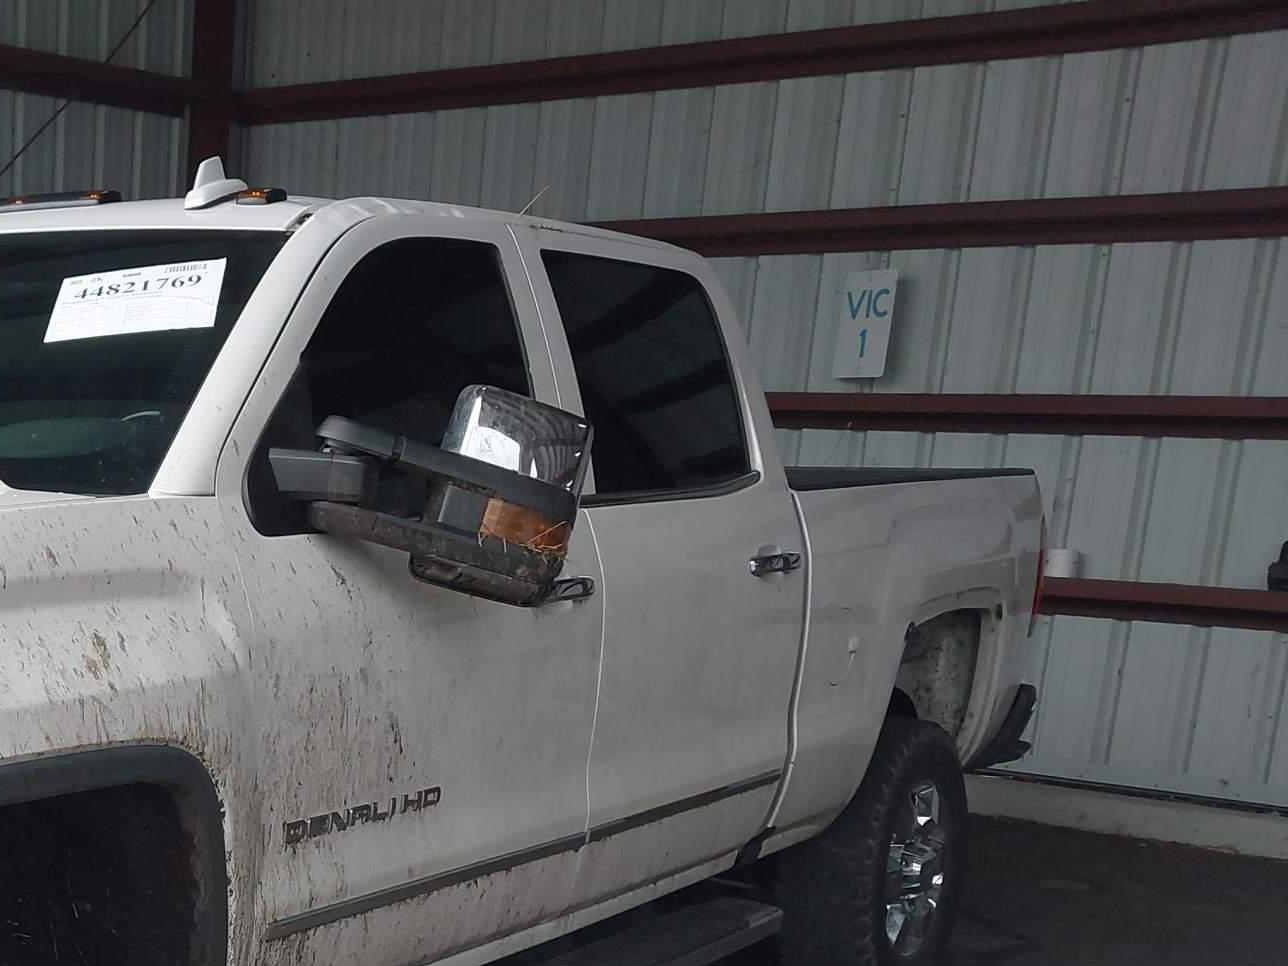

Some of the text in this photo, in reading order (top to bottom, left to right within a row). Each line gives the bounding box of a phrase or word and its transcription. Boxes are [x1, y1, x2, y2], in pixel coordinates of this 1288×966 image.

[73, 274, 202, 300] 44821769
[846, 287, 890, 320] VIC
[859, 328, 867, 358] 1
[283, 786, 441, 845] DENALI HD
